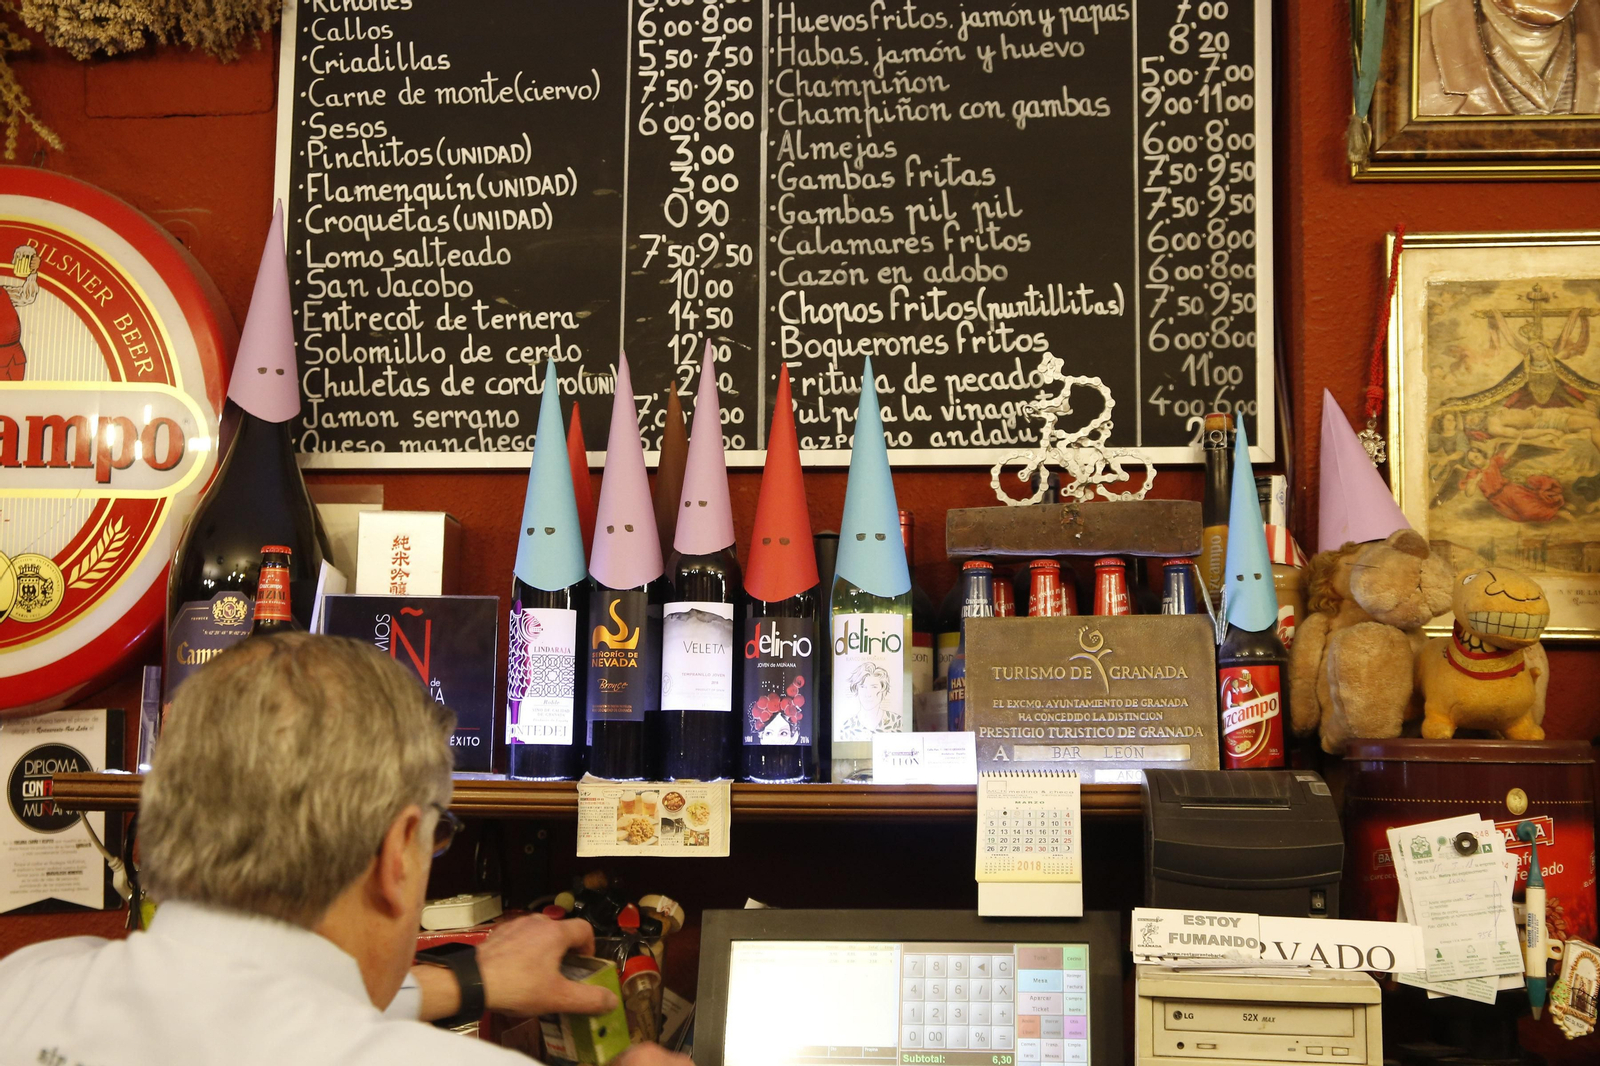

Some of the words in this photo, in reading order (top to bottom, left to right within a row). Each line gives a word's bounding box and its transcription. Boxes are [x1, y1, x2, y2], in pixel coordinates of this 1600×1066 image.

[311, 17, 394, 41] Callos
[776, 3, 868, 33] Huevos
[957, 3, 1036, 42] jamón
[1038, 8, 1056, 38] y
[1060, 2, 1131, 36] papas
[310, 41, 451, 75] Criadillas
[873, 38, 966, 78] jamón
[977, 43, 997, 74] y
[1000, 34, 1086, 59] huevo
[308, 77, 387, 108] Carne
[397, 76, 426, 105] de
[775, 69, 951, 108] Champiñon
[309, 112, 388, 140] Sesos
[777, 98, 952, 137] Champiñon
[959, 100, 1005, 121] con
[1011, 86, 1111, 131] gambas
[776, 130, 898, 170] Almejas
[777, 162, 896, 192] Gambas
[905, 153, 997, 188] fritas
[777, 194, 896, 226] Gambas
[905, 189, 958, 235] pil
[972, 186, 1023, 235] pil
[305, 240, 395, 269] Lomo
[393, 236, 512, 269] salteado
[777, 226, 935, 256] Calamares
[943, 222, 1032, 252] fritos
[306, 271, 369, 299] San
[376, 268, 474, 300] Jacobo
[777, 259, 869, 288] Cazón
[877, 263, 914, 284] en
[923, 253, 1008, 284] adobo
[26, 238, 114, 307] PILSNER
[113, 313, 155, 377] BEER
[302, 299, 425, 334] Entrecot
[437, 302, 468, 332] de
[472, 299, 580, 330] ternera
[778, 289, 884, 335] Chopos
[303, 332, 446, 366] Solomillo
[460, 333, 492, 364] de
[505, 335, 583, 364] cerdo
[780, 324, 949, 370] Boquerones
[956, 320, 1050, 355] fritos
[302, 362, 431, 399] Chuletas
[442, 365, 475, 397] de
[903, 361, 938, 393] de
[945, 356, 1046, 405] pecado
[303, 398, 399, 431] Jamon
[413, 407, 520, 431] serrano
[901, 394, 932, 422] la
[301, 430, 386, 454] Queso
[400, 428, 537, 454] manchego
[533, 646, 571, 654] LINDARAJA
[683, 640, 726, 654] VELETA
[745, 620, 813, 659] delirio
[834, 618, 902, 656] delirio
[591, 658, 638, 668] NEVADA
[592, 650, 625, 658] SEÑORÍO
[430, 677, 441, 687] de
[993, 666, 1066, 680] TURISMO
[1071, 666, 1092, 680] DE
[1110, 665, 1188, 680] GRANADA
[993, 699, 1006, 709] EL
[1046, 699, 1125, 709] AYUNTAMIENTO
[1125, 699, 1140, 709] DE
[1141, 699, 1188, 708] GRANADA
[1018, 712, 1032, 722] HA
[1034, 712, 1091, 722] CONCEDIDO
[1092, 712, 1107, 722] LA
[1108, 712, 1163, 722] DISTINCION
[979, 727, 1046, 739] PRESTIGIO
[1048, 727, 1115, 739] TURISTICO
[1116, 727, 1136, 739] DE
[1138, 726, 1204, 739] GRANADA
[25, 759, 79, 775] DIPLOMA
[993, 746, 1012, 762] A
[1051, 746, 1081, 760] BAR
[1104, 744, 1146, 760] LEÓN
[1017, 860, 1041, 871] 2018
[1183, 914, 1241, 928] ESTOY
[1168, 932, 1258, 949] FUMANDO
[1183, 1012, 1194, 1020] LG
[1242, 1013, 1259, 1022] 52X
[902, 1054, 946, 1064] Subtotal:
[992, 1055, 1012, 1066] 6,30
